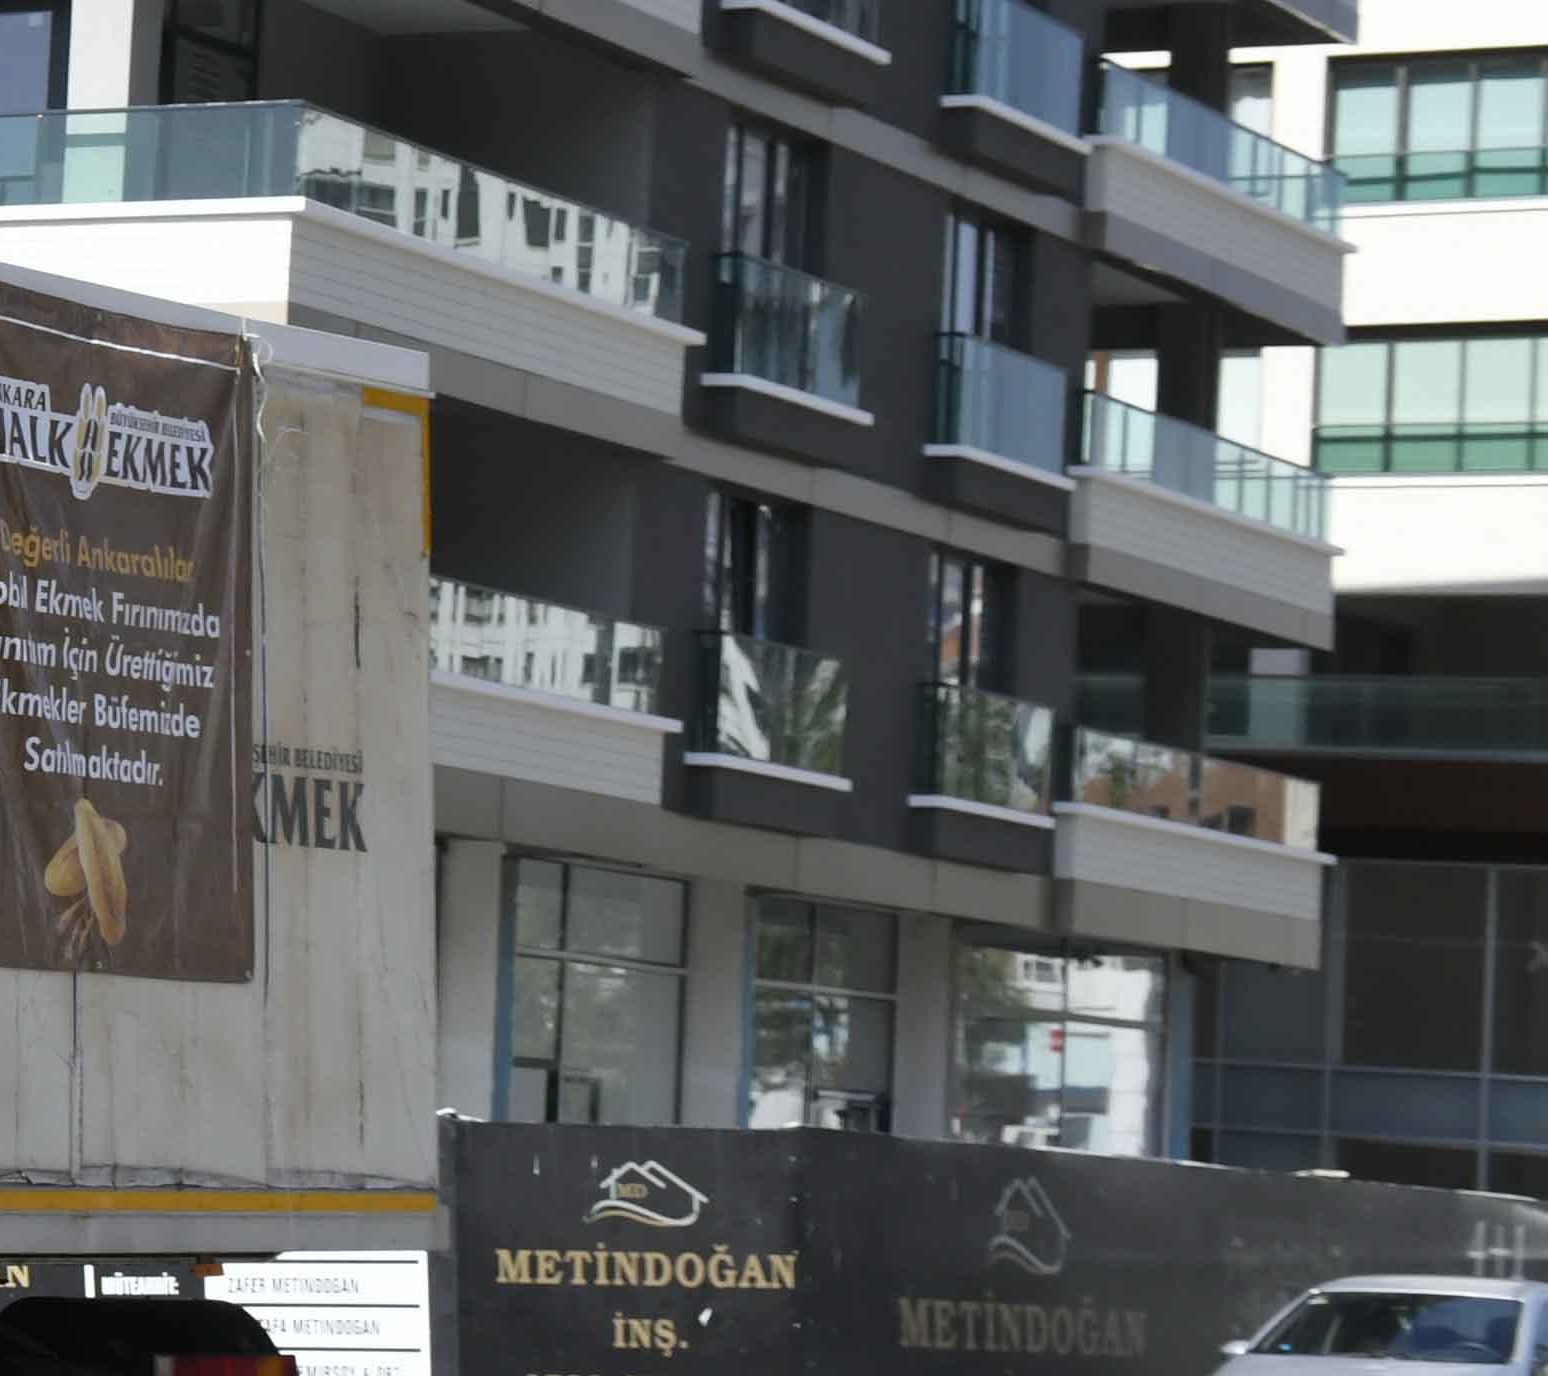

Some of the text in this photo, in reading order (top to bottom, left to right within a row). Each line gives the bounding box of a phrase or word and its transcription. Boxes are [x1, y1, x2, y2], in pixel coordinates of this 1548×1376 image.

[107, 430, 213, 491] EKMEK
[0, 520, 195, 582] Değerli Ankaralılar
[35, 578, 105, 624] Ekmek
[62, 627, 97, 681] İçin
[93, 692, 201, 739] Büfemizde
[23, 736, 163, 787] Satılmaktadır.
[495, 1242, 797, 1289] METİNDOĞAN
[612, 1312, 689, 1357] İNŞ.
[898, 1290, 1148, 1358] METİNDOĞAN
